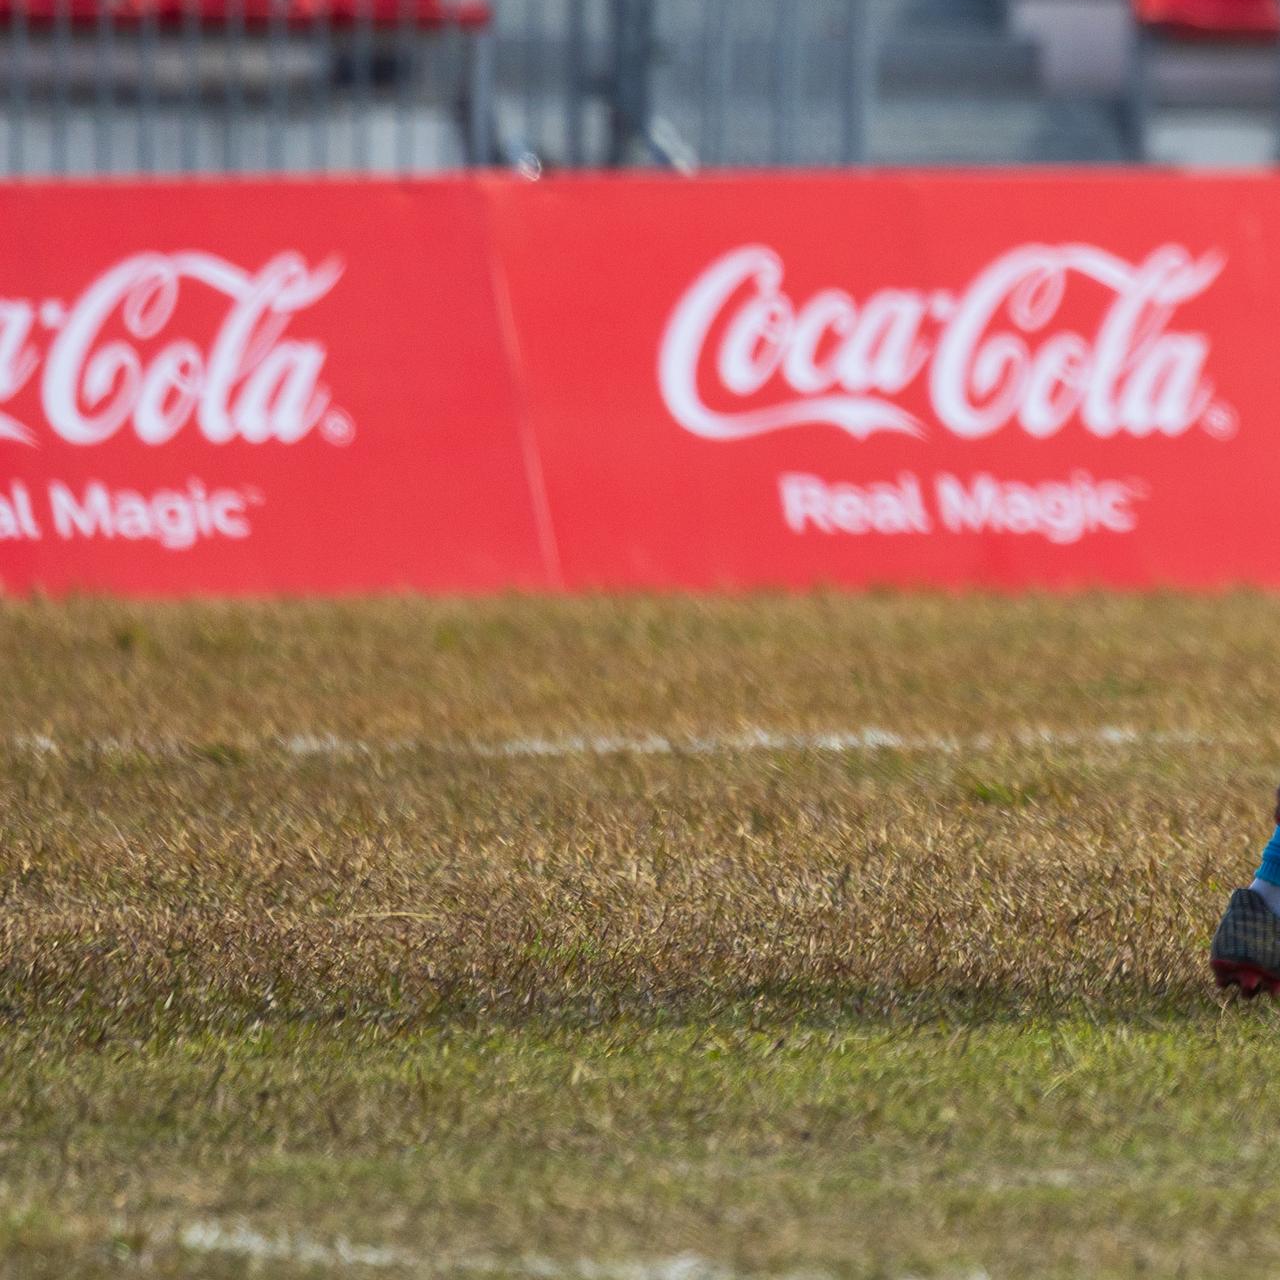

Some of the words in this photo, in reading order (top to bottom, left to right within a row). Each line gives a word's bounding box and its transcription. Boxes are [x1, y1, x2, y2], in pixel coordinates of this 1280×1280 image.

[47, 476, 252, 550] Magic
[777, 470, 933, 535] Real
[935, 469, 1138, 546] Magic
